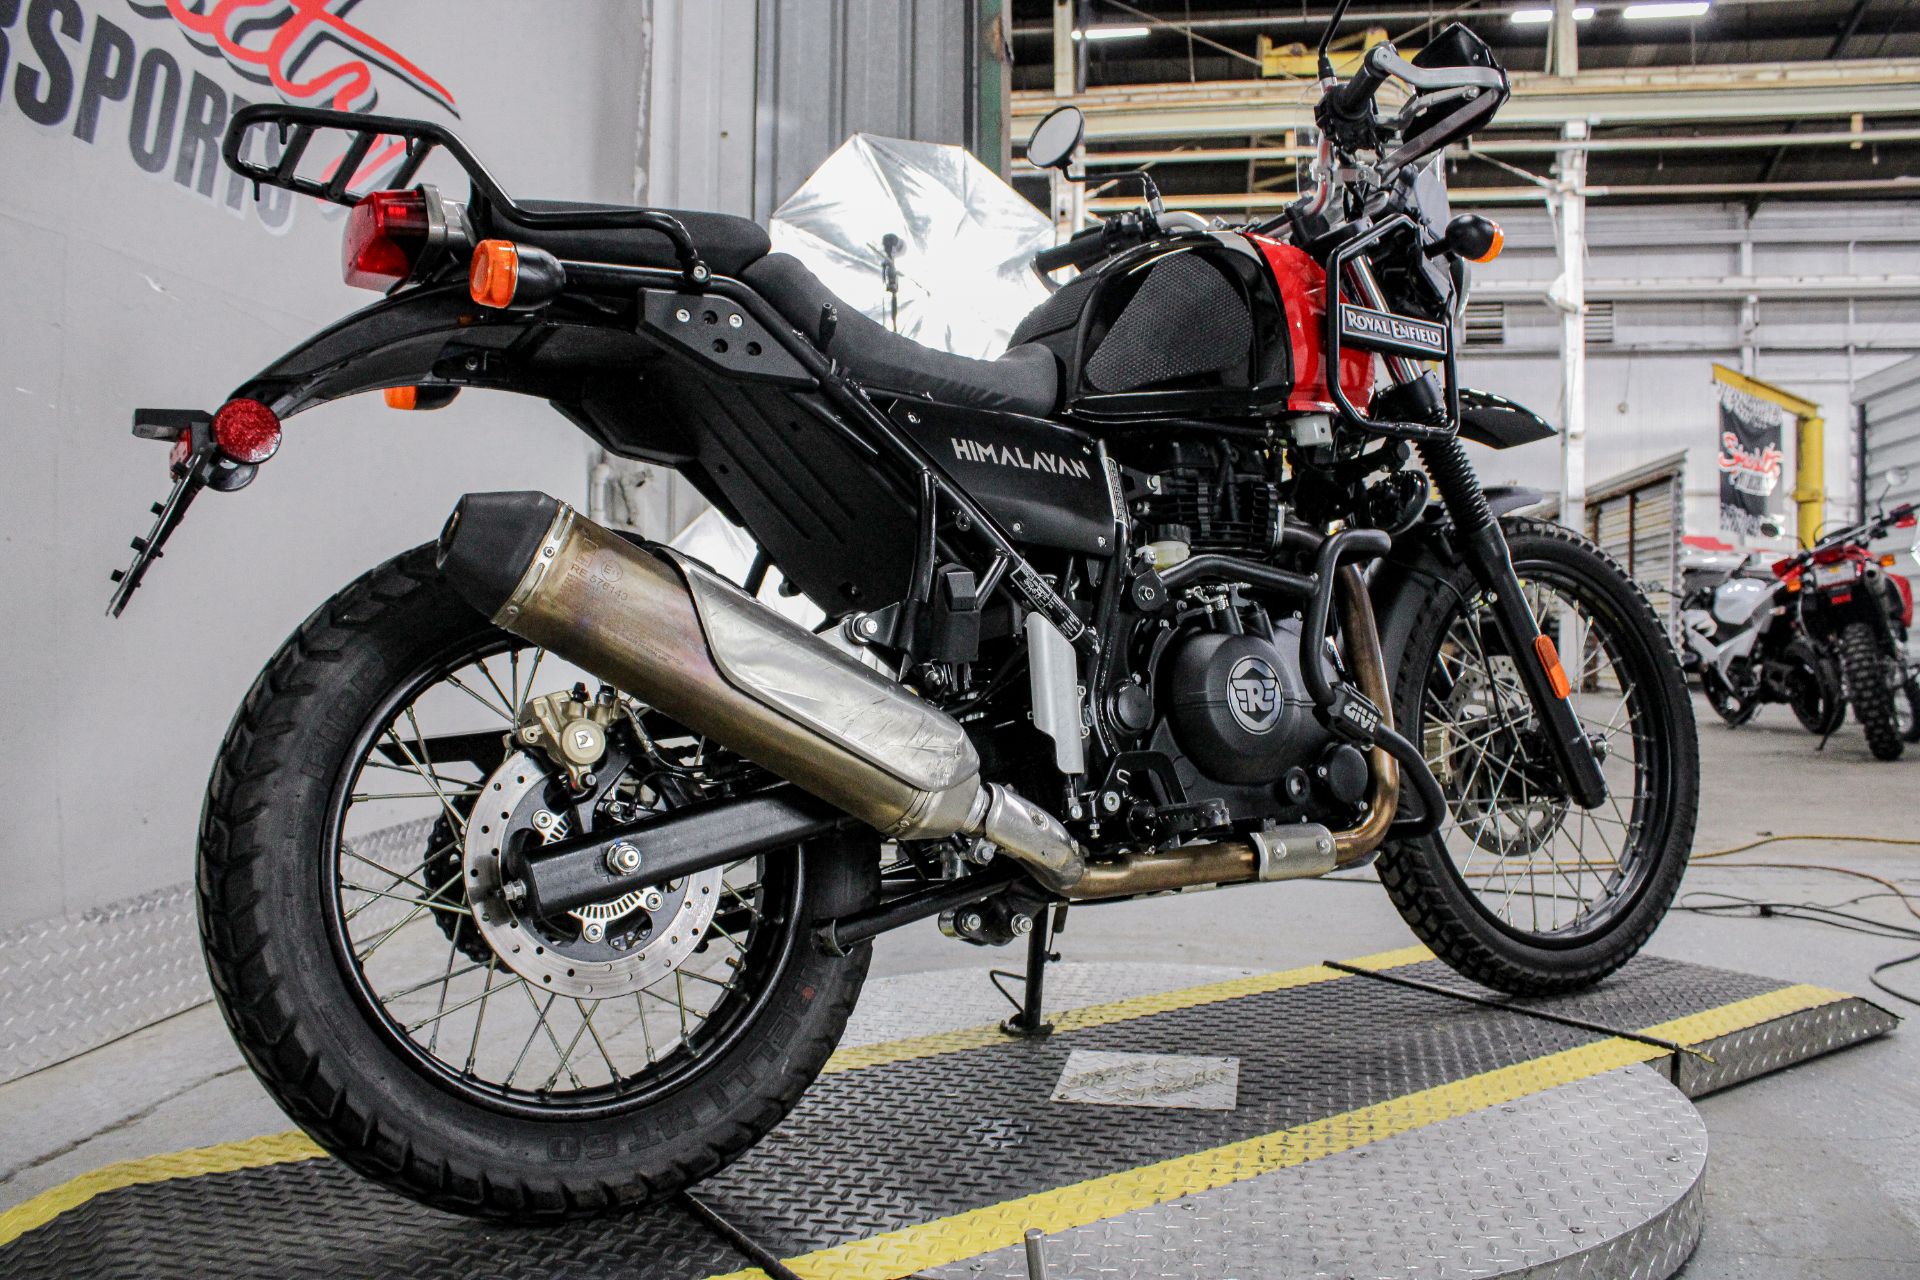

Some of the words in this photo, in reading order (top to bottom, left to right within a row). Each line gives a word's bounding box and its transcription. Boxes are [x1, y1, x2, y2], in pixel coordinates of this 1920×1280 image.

[1345, 310, 1390, 334] ROYAL
[1390, 319, 1441, 346] ENFIELD
[950, 437, 1091, 480] HIMALAYAN
[1343, 701, 1378, 733] GIVI
